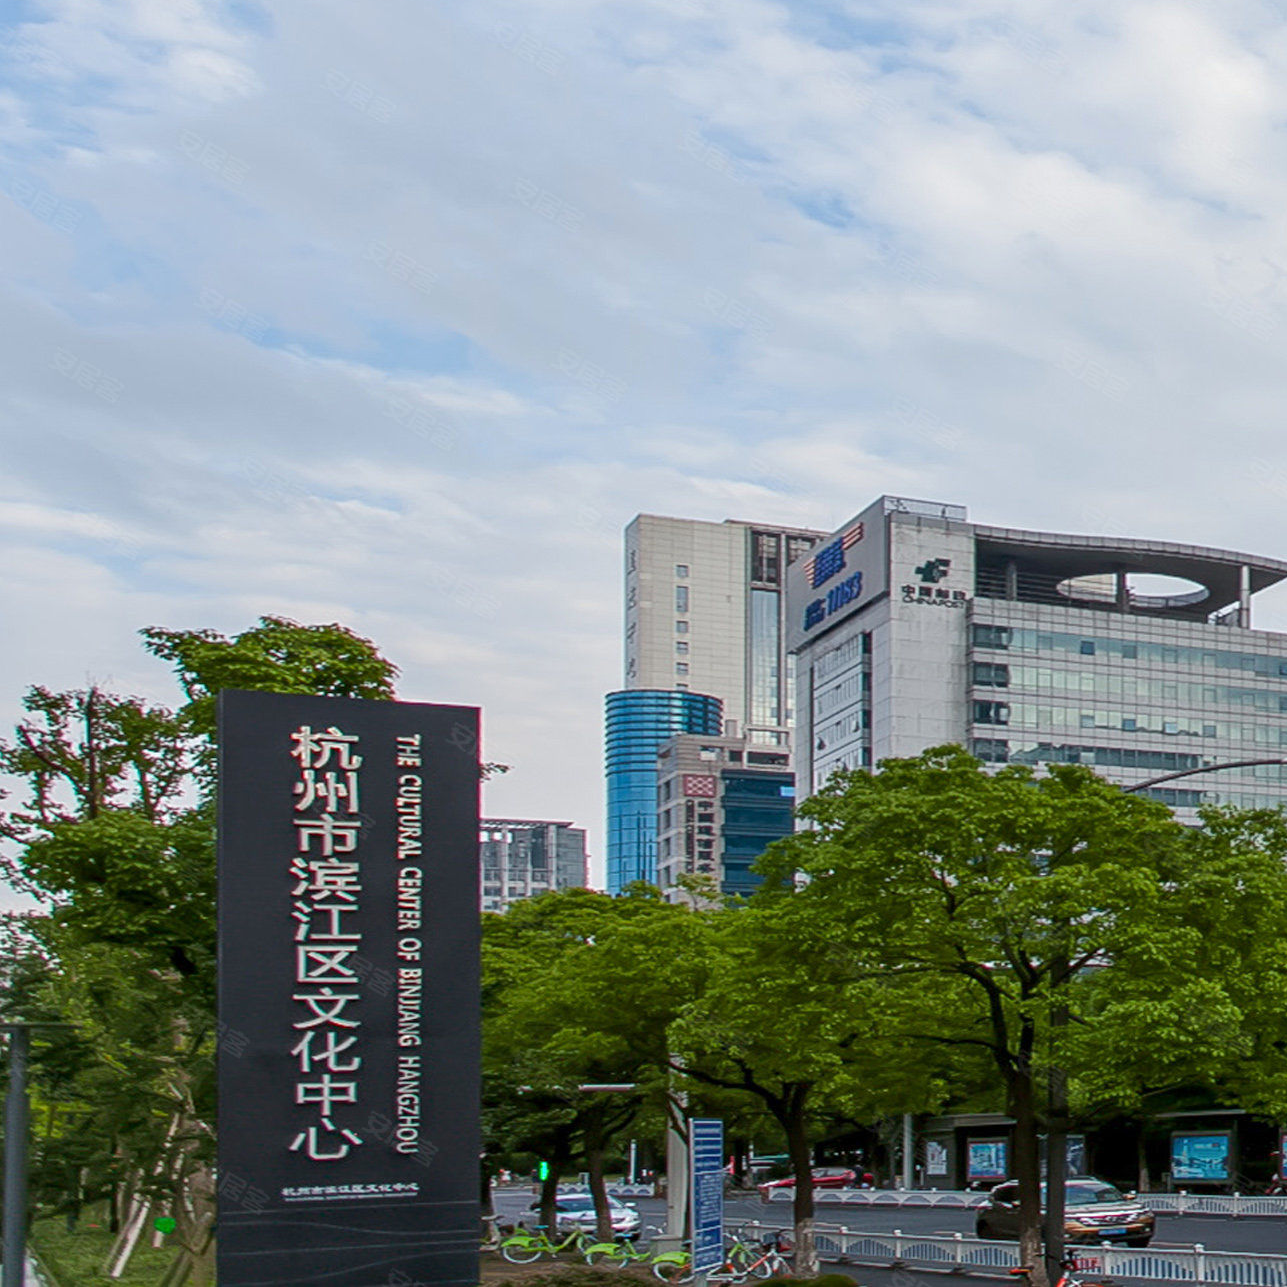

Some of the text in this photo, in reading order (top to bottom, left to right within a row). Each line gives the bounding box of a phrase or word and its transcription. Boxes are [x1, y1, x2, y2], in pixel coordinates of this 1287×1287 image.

[290, 726, 362, 1160] 杭州市滨江区文化中心
[397, 733, 422, 1155] THE CULTURAL CENTER OF BINJIANG HANGZHOU
